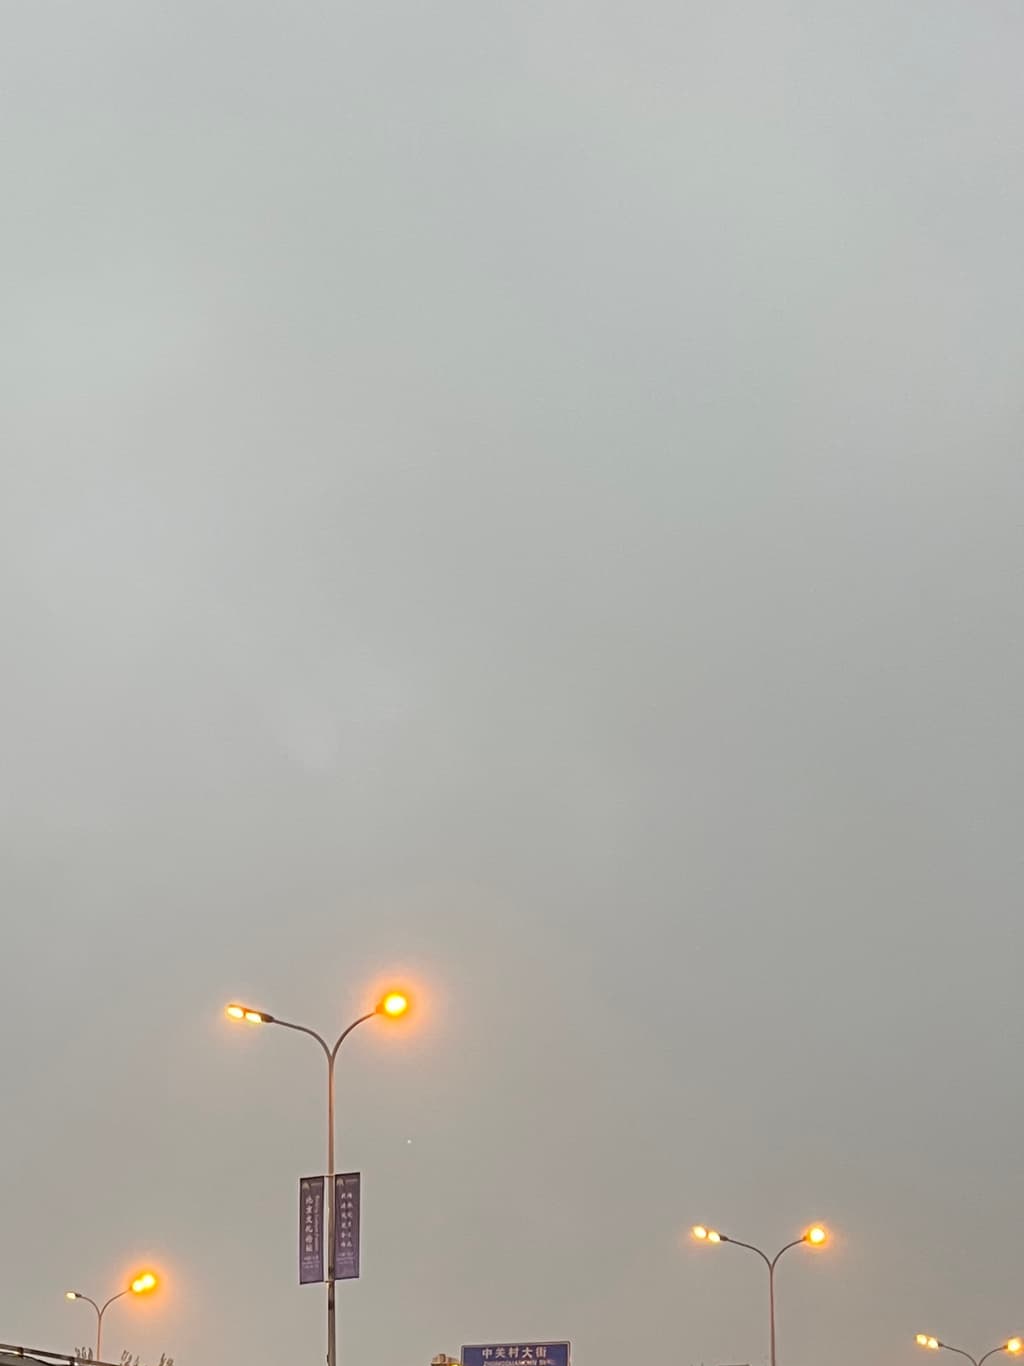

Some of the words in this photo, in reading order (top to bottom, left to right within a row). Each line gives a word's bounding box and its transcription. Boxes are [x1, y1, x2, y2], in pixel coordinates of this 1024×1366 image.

[482, 1346, 547, 1359] 中关村大街
